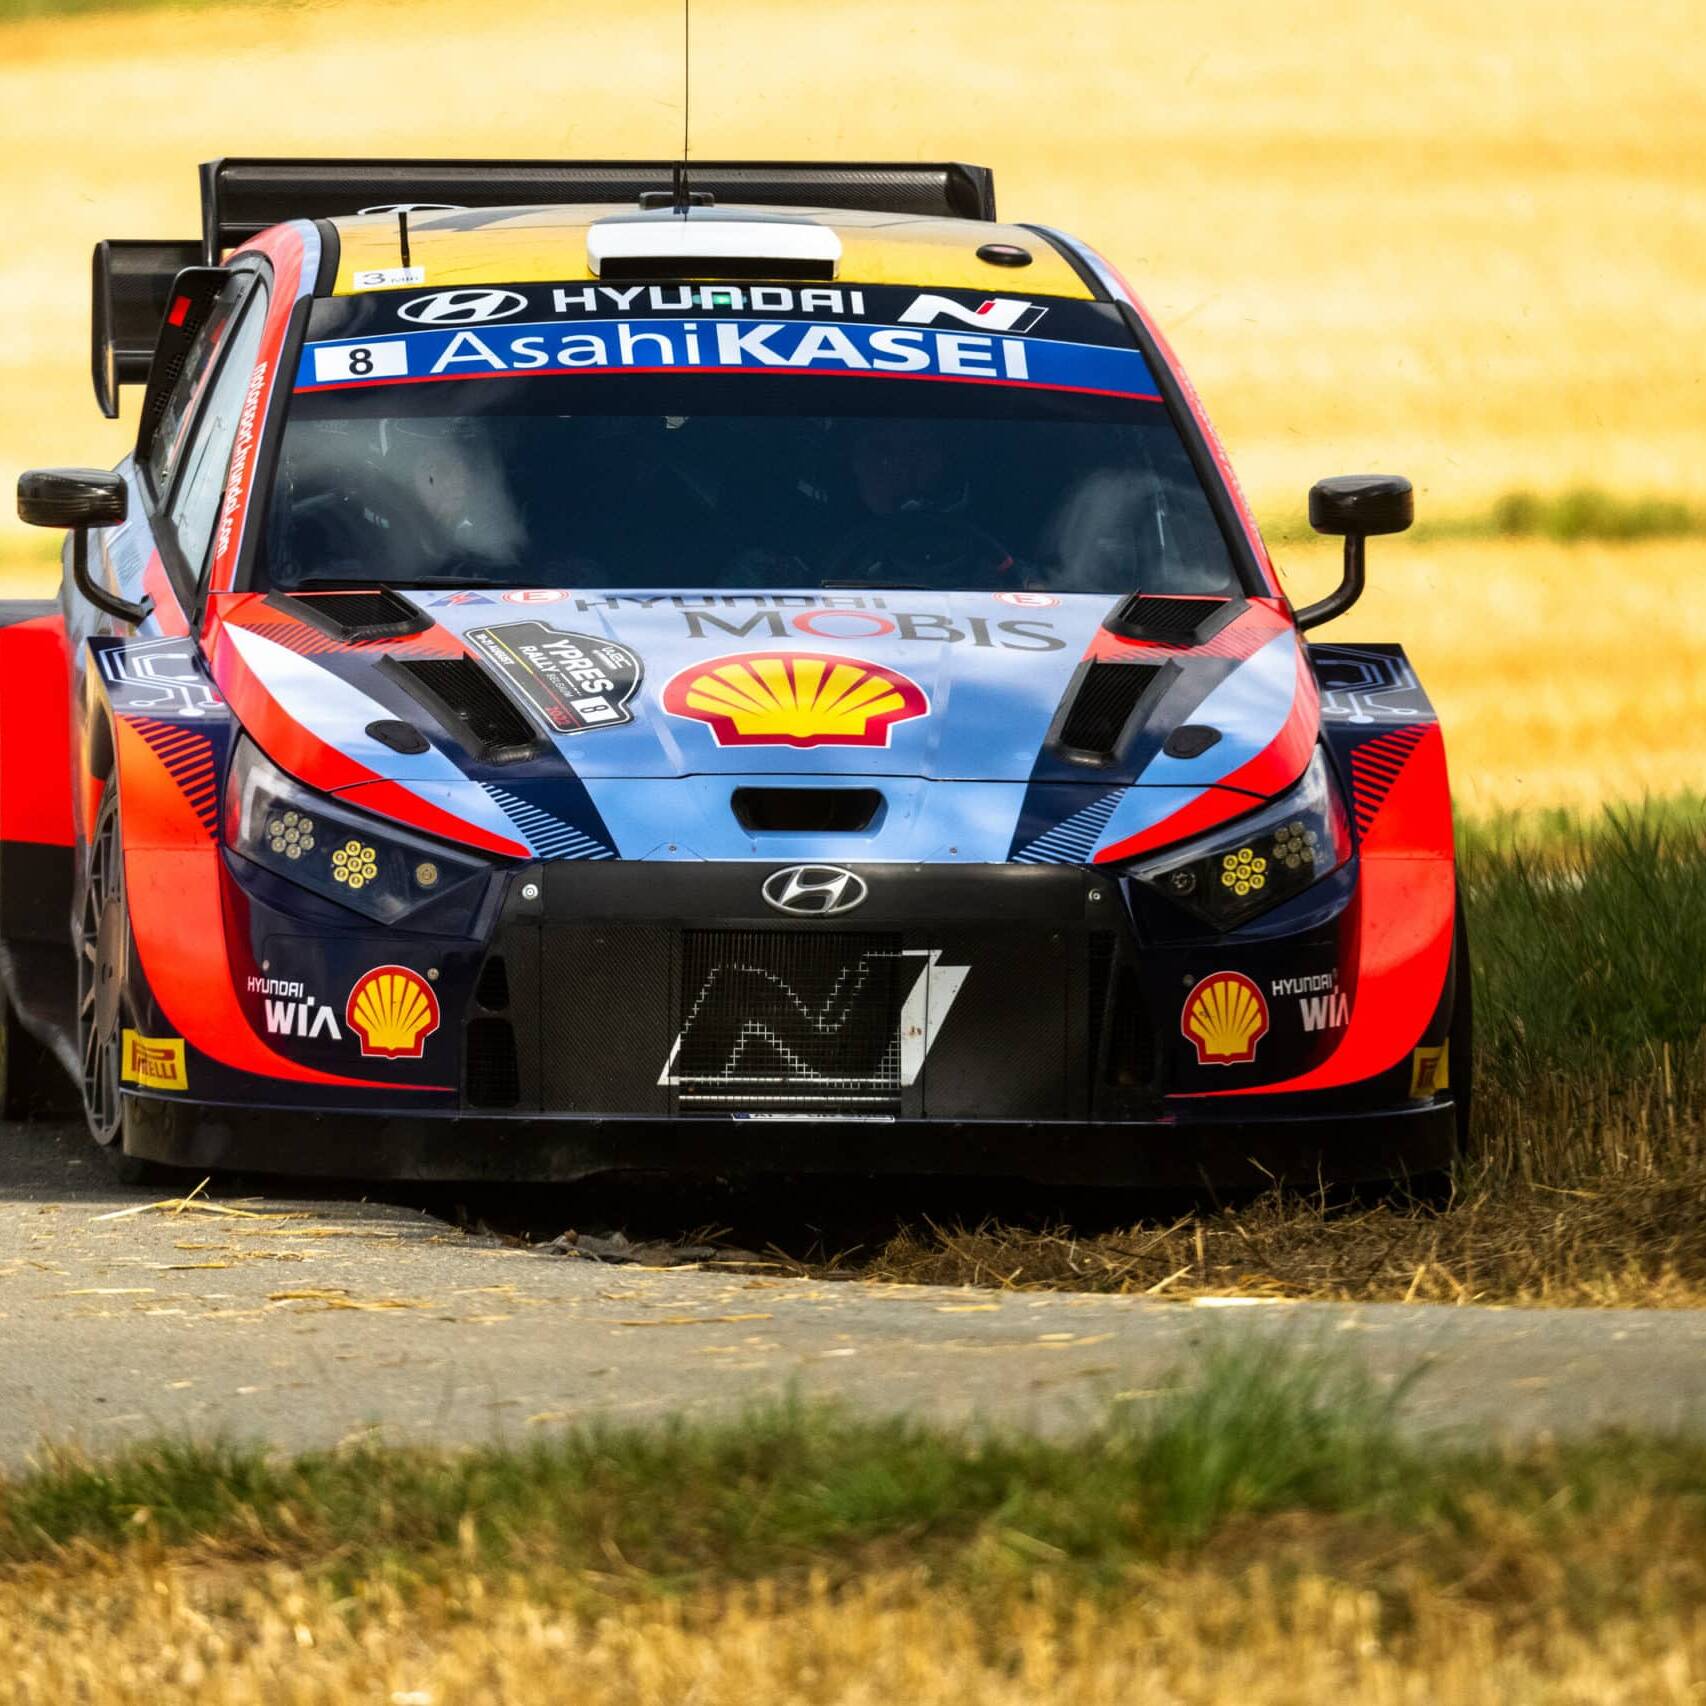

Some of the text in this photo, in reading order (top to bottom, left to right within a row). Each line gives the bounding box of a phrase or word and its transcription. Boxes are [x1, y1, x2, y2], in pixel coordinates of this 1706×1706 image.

[553, 285, 866, 316] HYUNDAI
[348, 347, 374, 376] 8
[575, 593, 887, 612] HYUNDAI
[687, 609, 1066, 652] MOBIS
[518, 645, 561, 672] RALLY
[541, 639, 615, 693] YPRES
[580, 704, 609, 714] 8
[247, 976, 304, 998] HYUNDAI
[1272, 974, 1333, 996] HYUNDAI
[131, 1040, 177, 1080] PIRELLI
